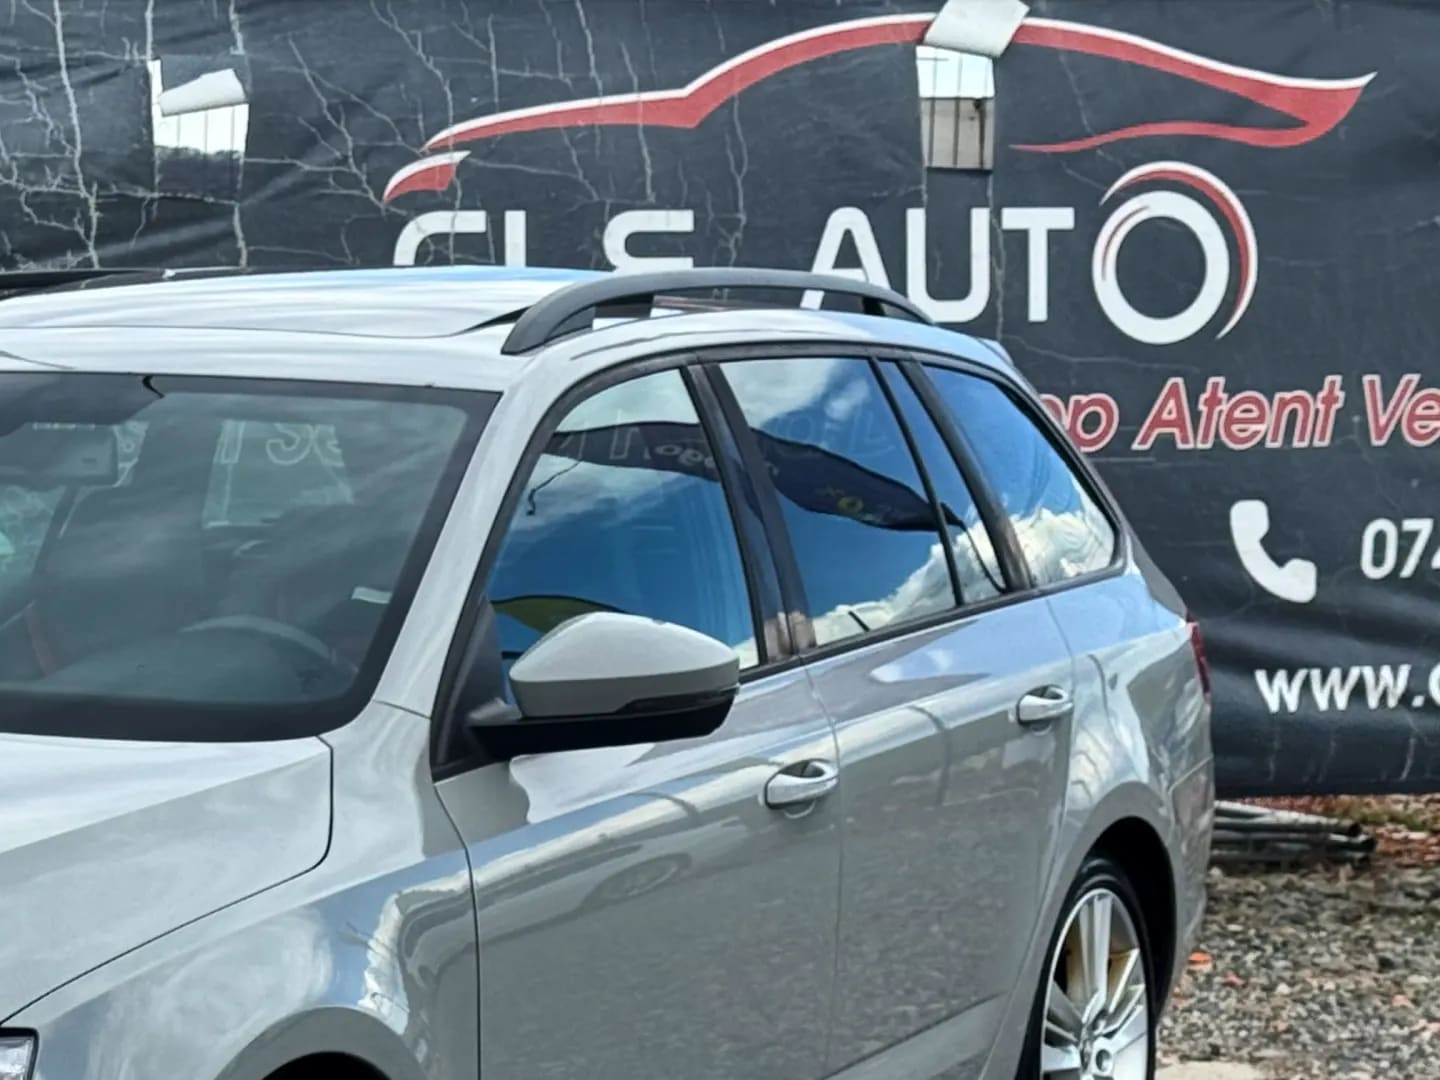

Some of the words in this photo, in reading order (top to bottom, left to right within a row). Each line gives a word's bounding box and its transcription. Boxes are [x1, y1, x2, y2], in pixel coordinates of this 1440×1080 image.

[799, 190, 1230, 345] AUTO
[1130, 374, 1345, 451] Atent
[1361, 517, 1440, 580] 07
